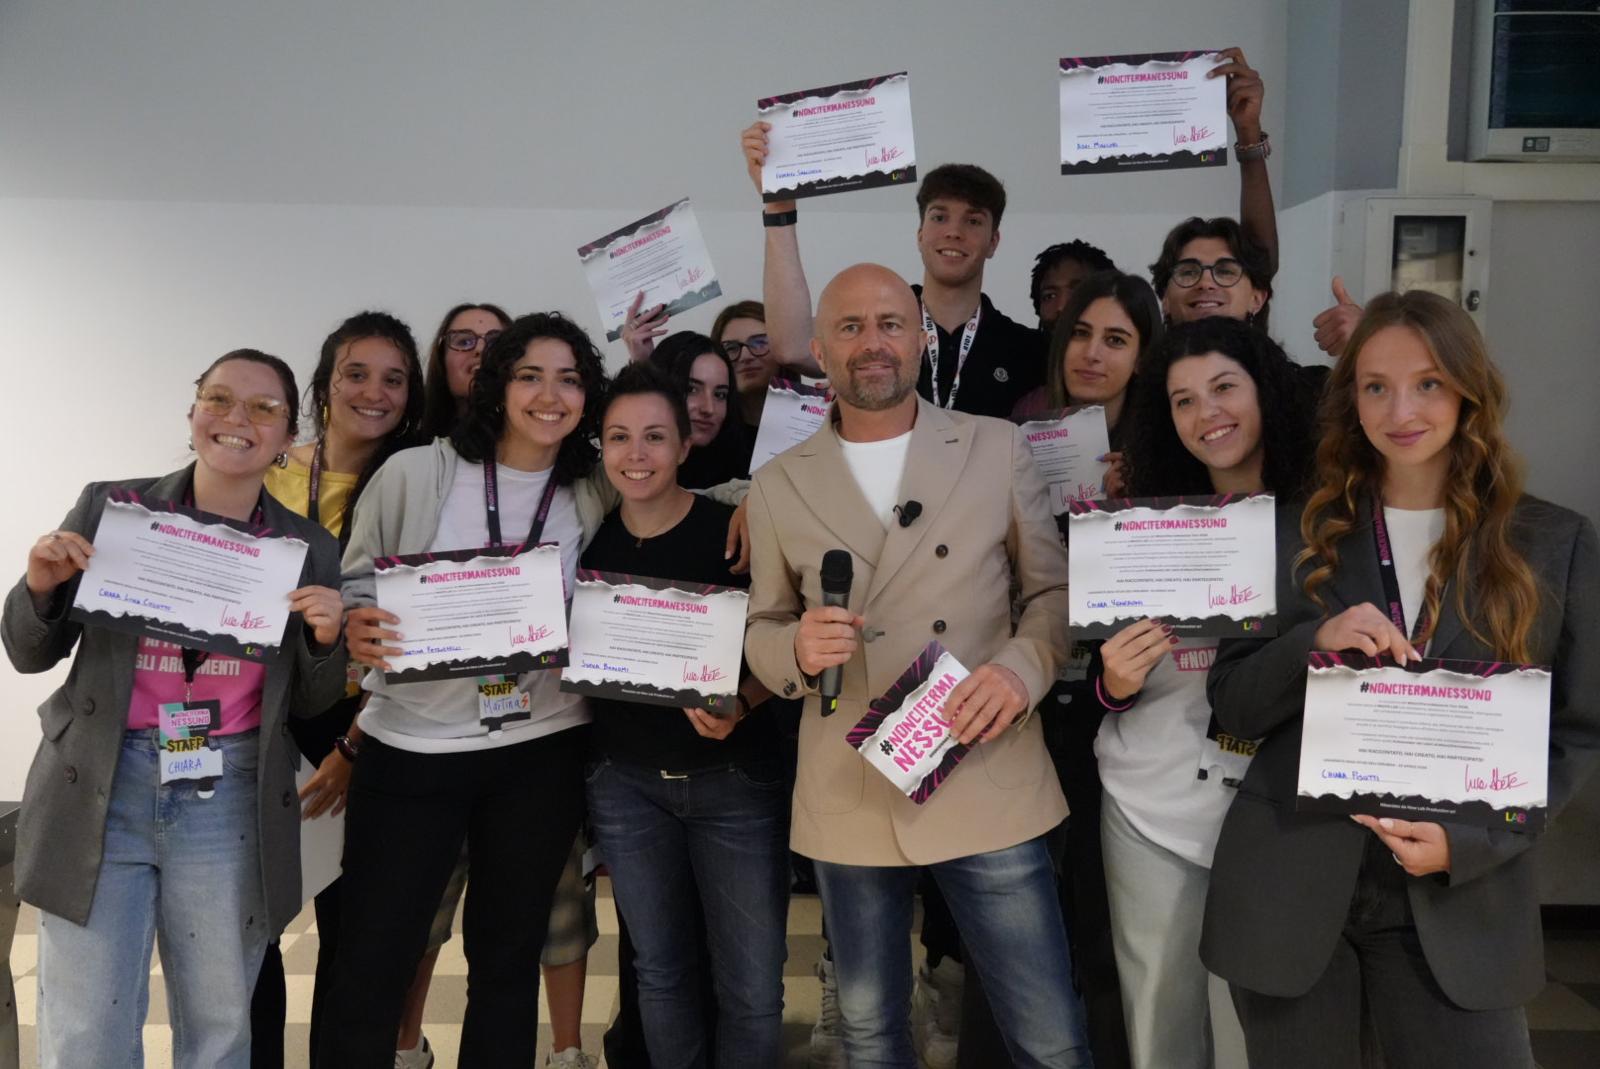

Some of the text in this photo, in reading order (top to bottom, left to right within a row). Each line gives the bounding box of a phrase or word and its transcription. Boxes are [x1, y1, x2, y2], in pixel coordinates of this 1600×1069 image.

[801, 403, 826, 416] #NONC
[1114, 518, 1227, 531] #NONCIFERMANESSUNO
[150, 521, 261, 557] #NONCIFERMANESSUNO
[420, 566, 520, 584] #NONCIFERMANESSUNO
[613, 594, 708, 614] #NONCIFERMANESSUNO
[484, 683, 513, 696] STAFF
[1360, 681, 1492, 701] #NONCIFERMANESSUNO
[879, 673, 958, 756] #NONCIFERMA
[167, 736, 204, 753] STAFF
[168, 757, 202, 774] CHIARA
